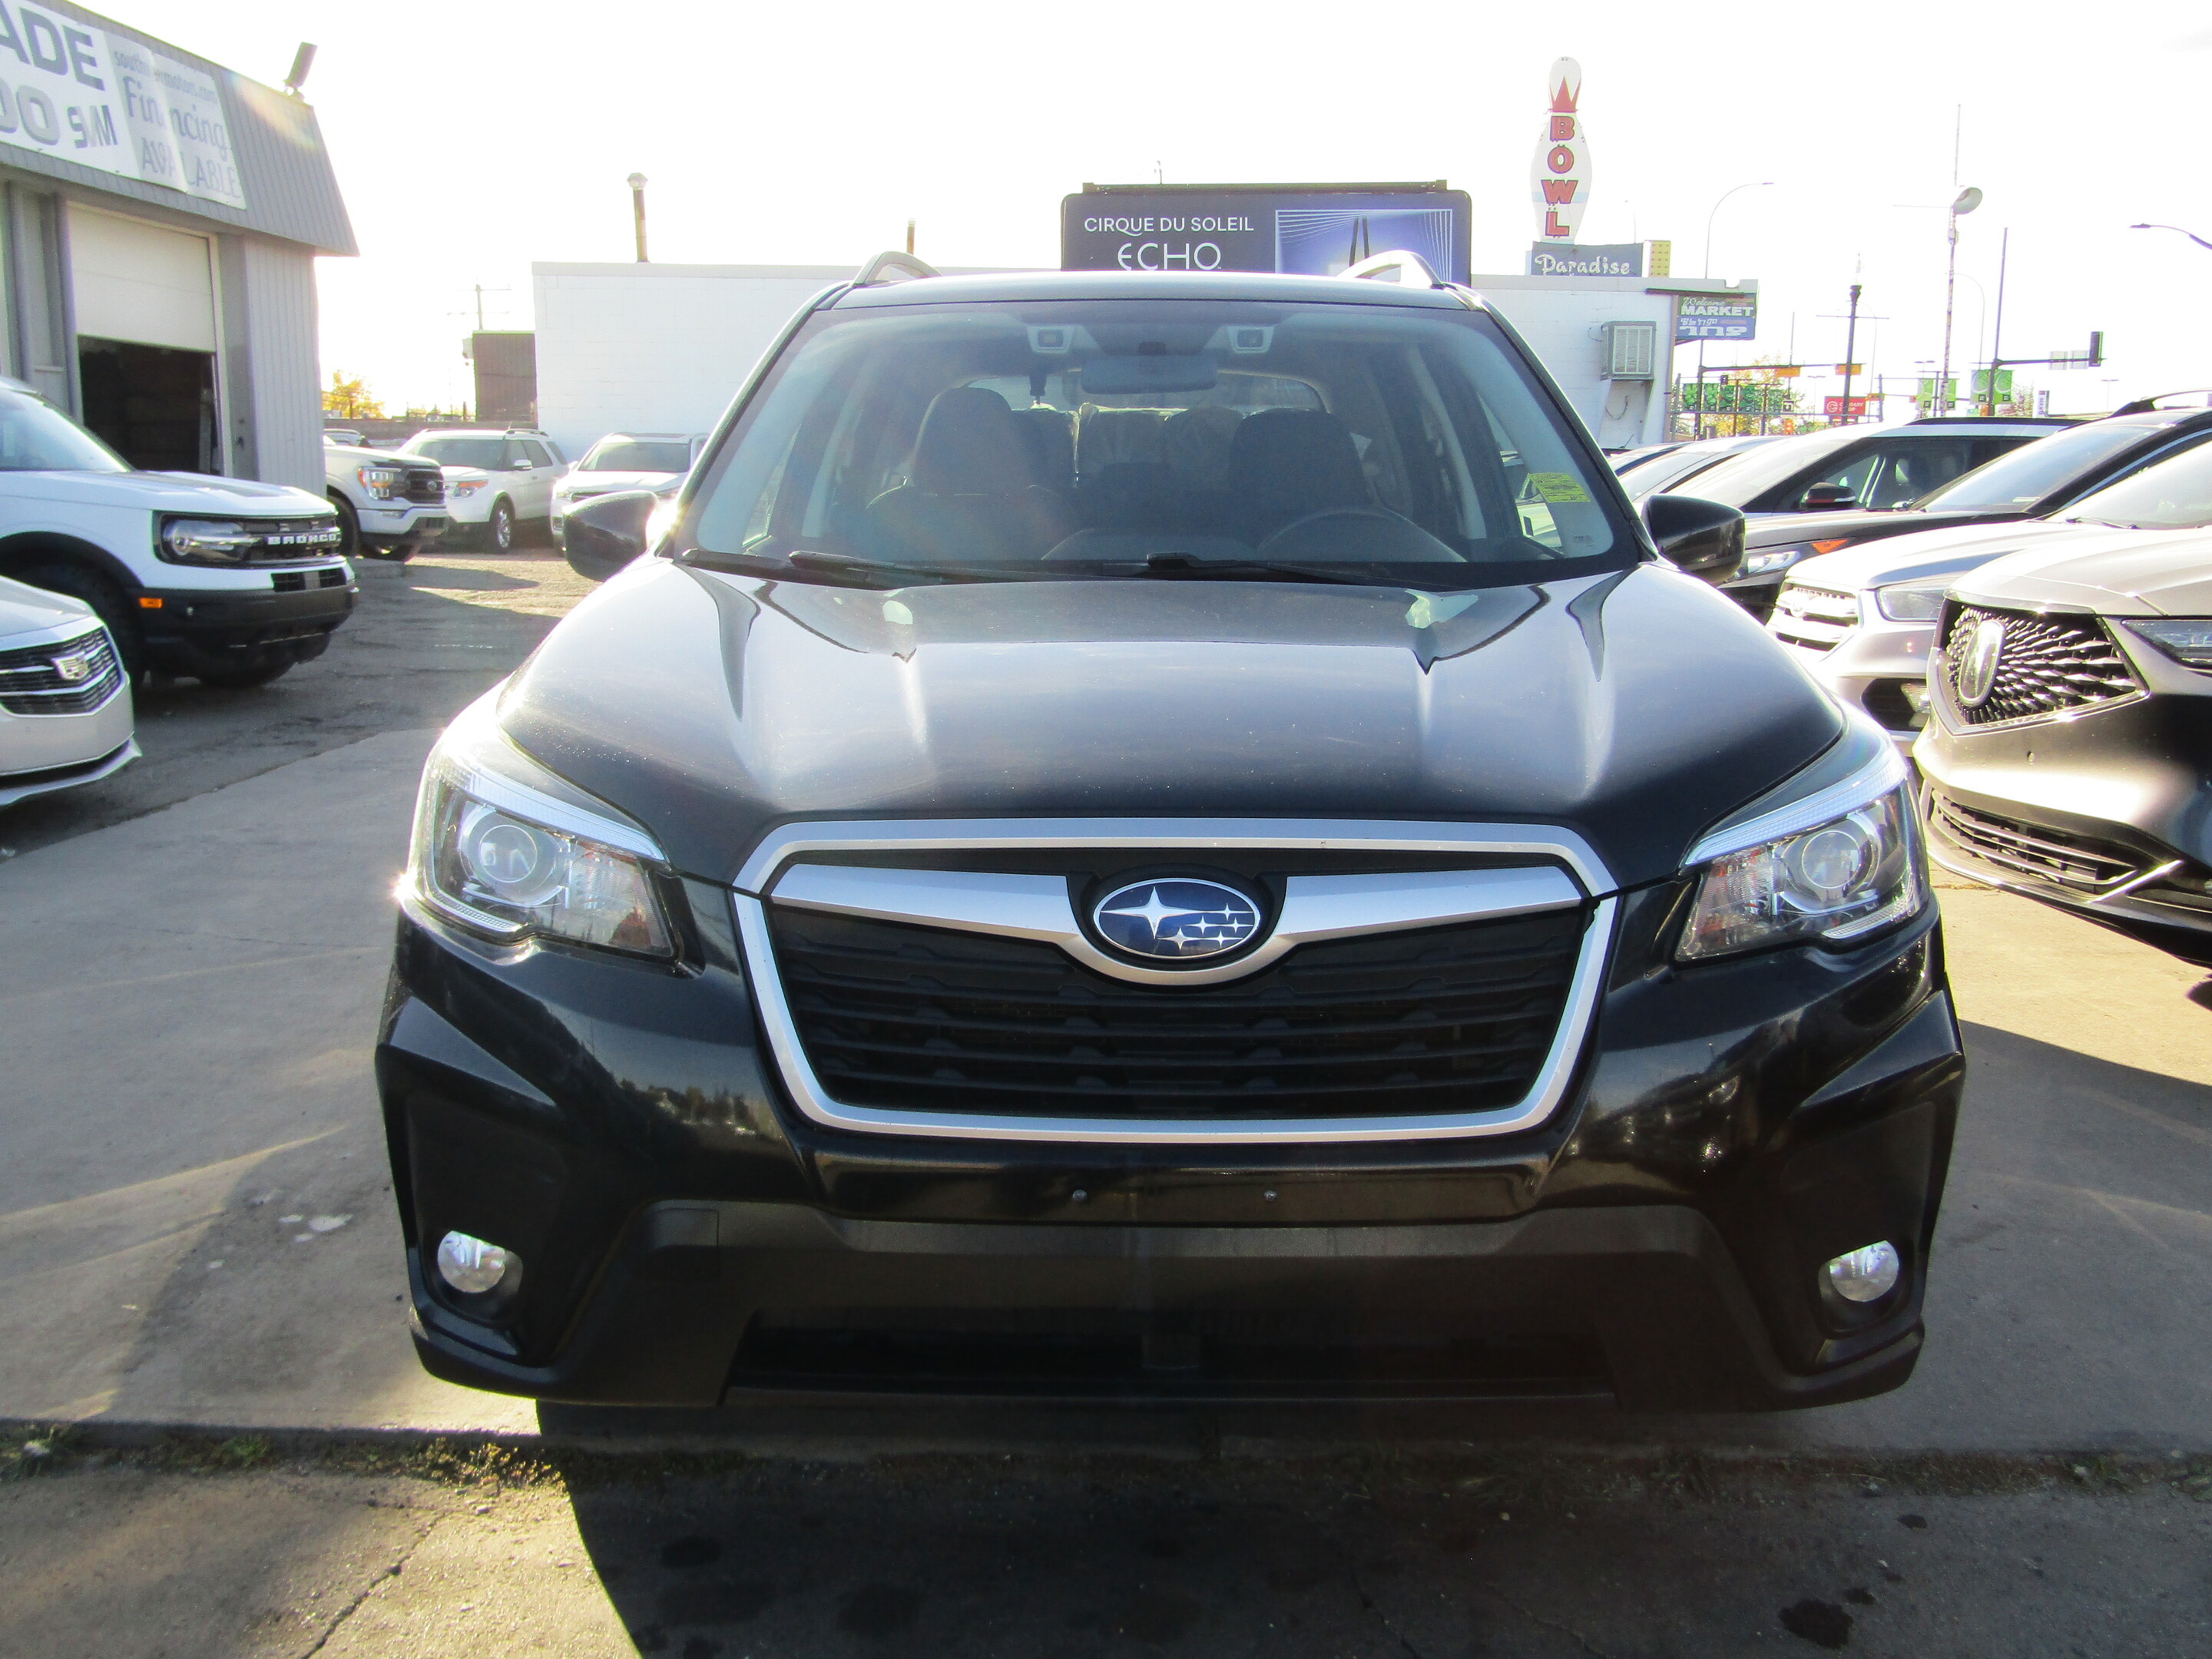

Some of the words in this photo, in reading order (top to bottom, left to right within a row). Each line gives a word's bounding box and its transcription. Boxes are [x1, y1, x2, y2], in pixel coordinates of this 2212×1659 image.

[123, 75, 229, 162] Finncing
[1541, 116, 1578, 237] BOWL
[1084, 218, 1154, 237] CIRQUE
[1160, 217, 1185, 231] DU
[1190, 217, 1253, 231] SOLEIL
[1118, 242, 1221, 270] ECHO
[1535, 254, 1630, 276] Paradise
[1681, 306, 1753, 316] MARKET
[267, 534, 336, 545] BRONCO
